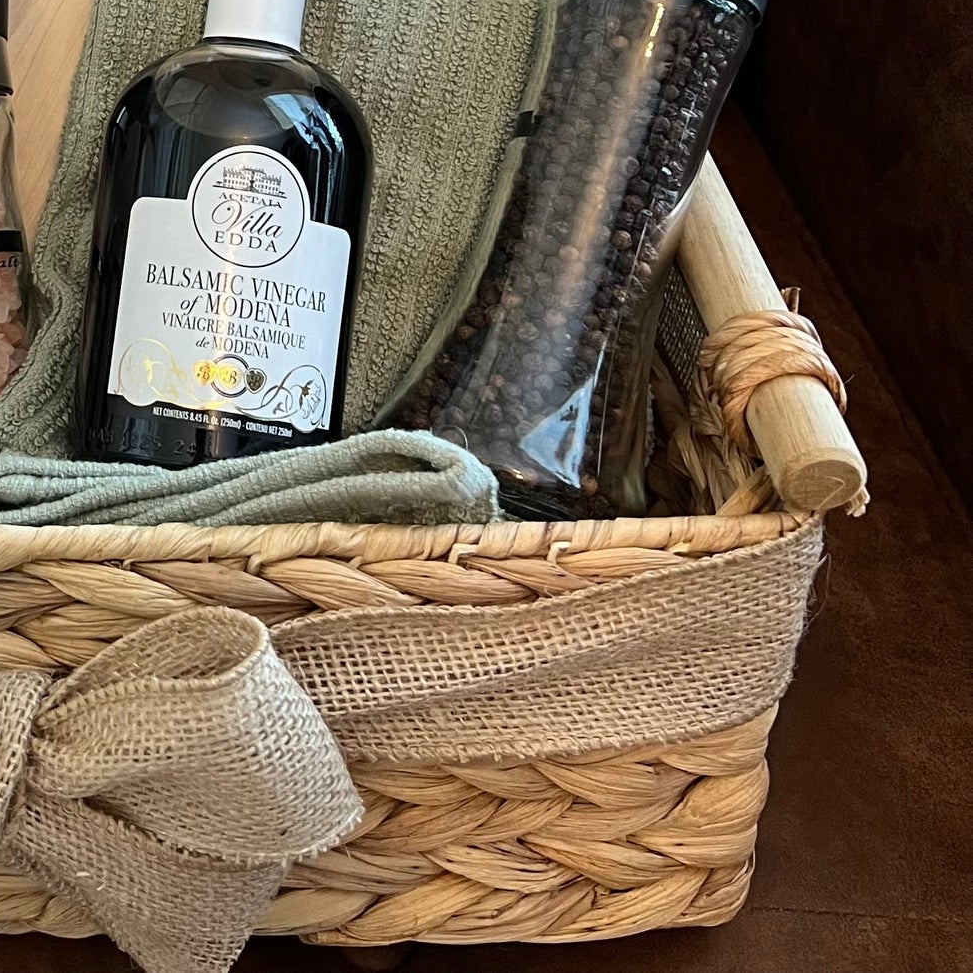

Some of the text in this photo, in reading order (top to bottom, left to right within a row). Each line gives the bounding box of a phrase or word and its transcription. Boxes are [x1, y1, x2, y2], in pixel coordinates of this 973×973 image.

[218, 191, 283, 209] ACETAIA
[211, 199, 284, 239] Villa
[214, 230, 278, 253] EDDA
[146, 263, 327, 313] BALSAMIC VINEGAR
[180, 293, 291, 328] of MODENA
[162, 311, 306, 350] VINAIGRE BALSAMIQUE
[195, 335, 269, 359] de MODENA
[152, 406, 163, 416] NET
[163, 407, 189, 420] CONTENTS
[189, 411, 202, 423] 8.45
